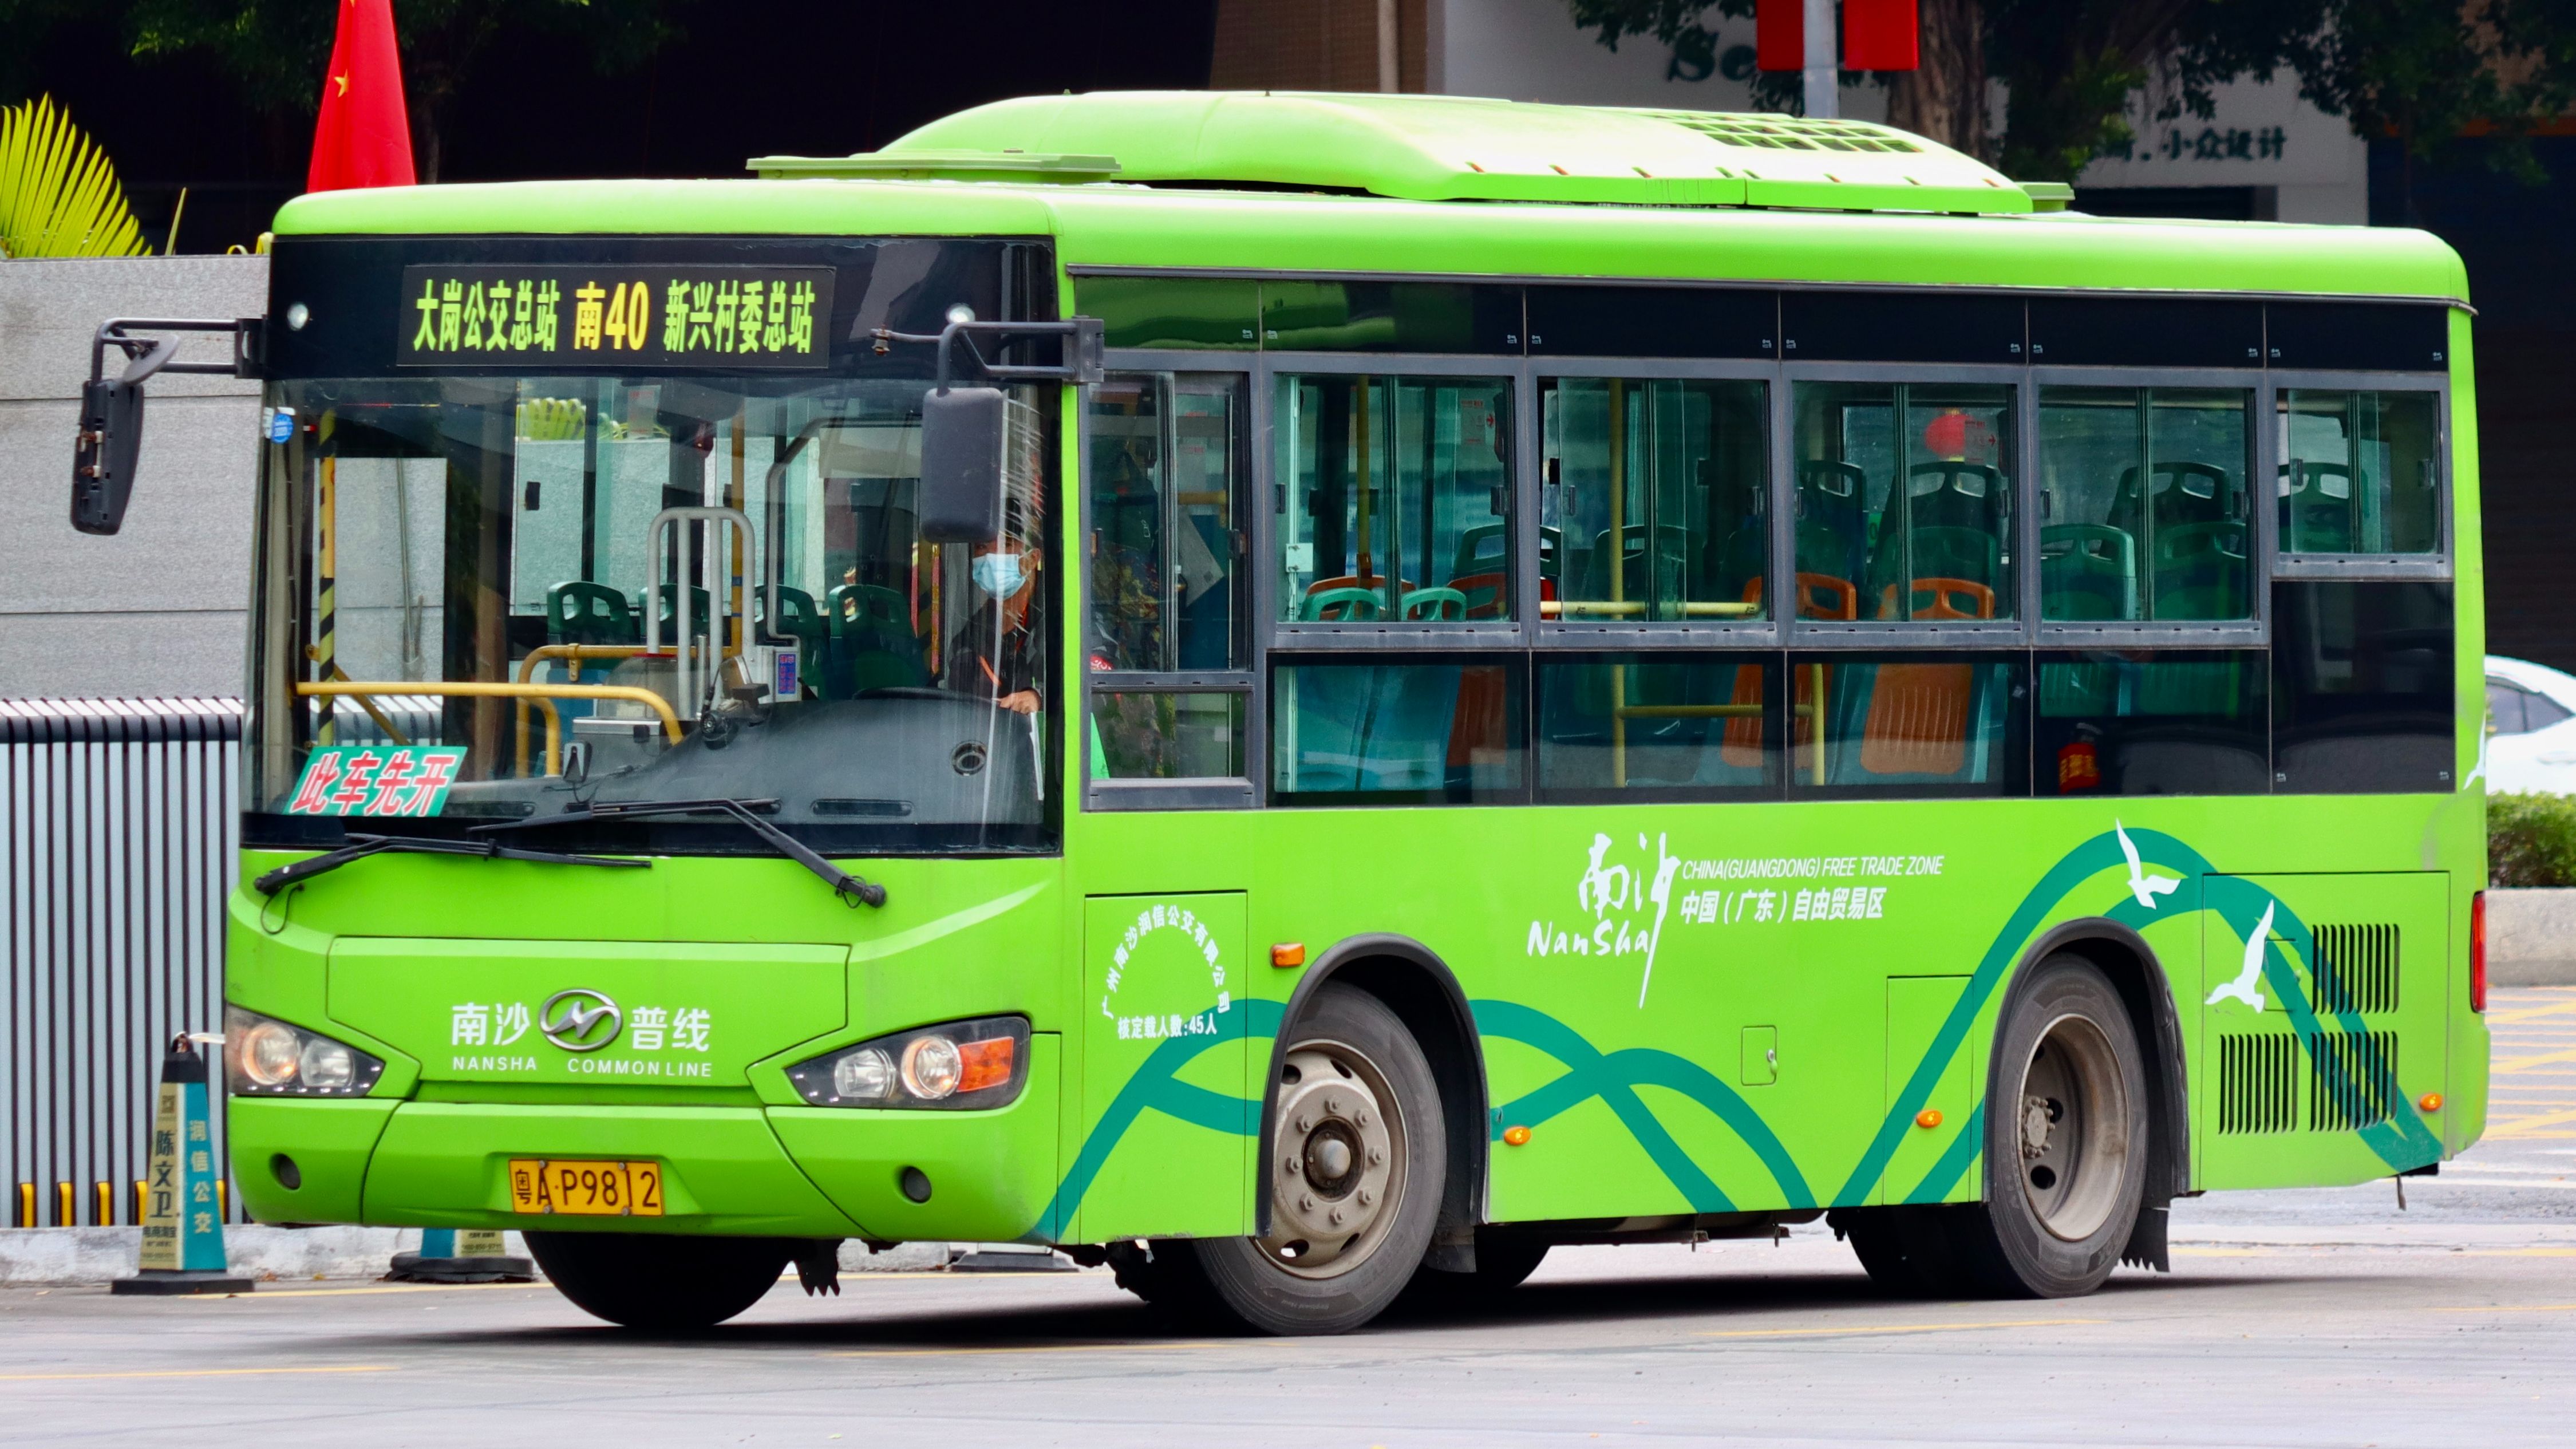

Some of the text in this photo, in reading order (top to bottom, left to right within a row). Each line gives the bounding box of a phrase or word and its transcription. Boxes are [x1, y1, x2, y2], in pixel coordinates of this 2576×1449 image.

[413, 278, 816, 354] 大岗公交总站 南40 新兴村委总站
[290, 749, 457, 816] 此车先开
[1681, 854, 1945, 880] CHINA(GUANGDONG) FREE TRADE ZONE
[1526, 919, 1649, 958] NanSha
[1578, 832, 1681, 1009] 南沙
[1101, 903, 1231, 1020] 广州南沙润信公交有限公司
[451, 1001, 711, 1052] 南沙 普线
[452, 1056, 712, 1077] NANSHA COMMON LINE
[149, 1130, 175, 1218] 陈文卫
[188, 1119, 212, 1234] 润信公交
